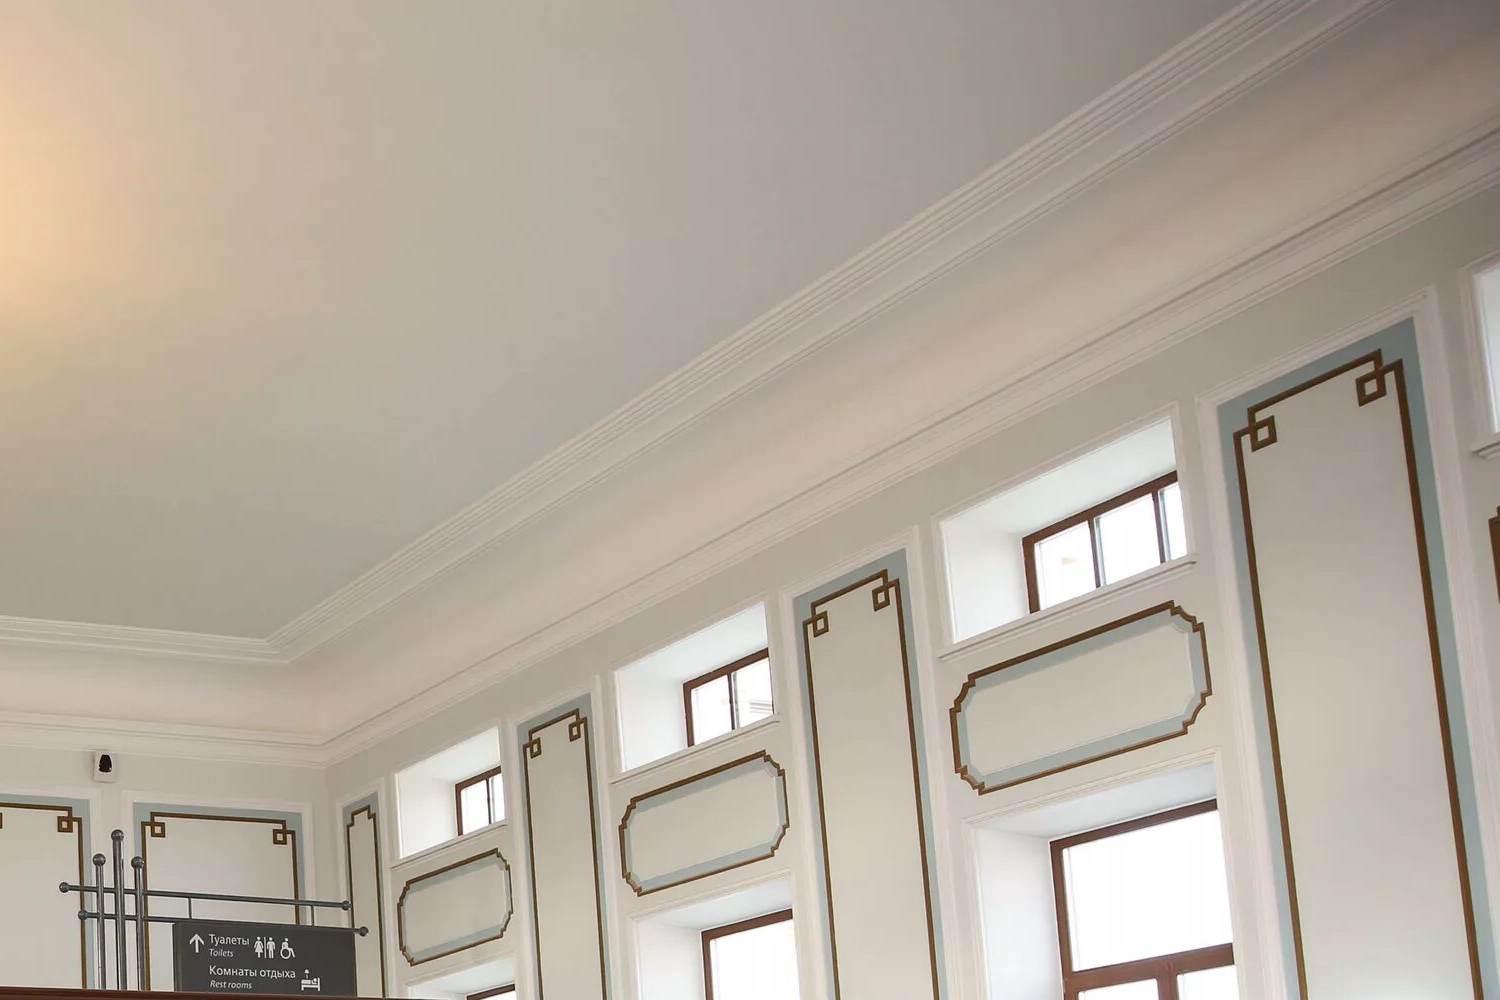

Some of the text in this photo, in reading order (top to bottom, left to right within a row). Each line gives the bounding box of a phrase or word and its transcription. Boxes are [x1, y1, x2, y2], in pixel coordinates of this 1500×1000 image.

[208, 933, 250, 946] Туалеты
[209, 949, 234, 958] Toilets
[209, 965, 296, 979] Комнаты отдыха
[210, 979, 226, 989] Rest
